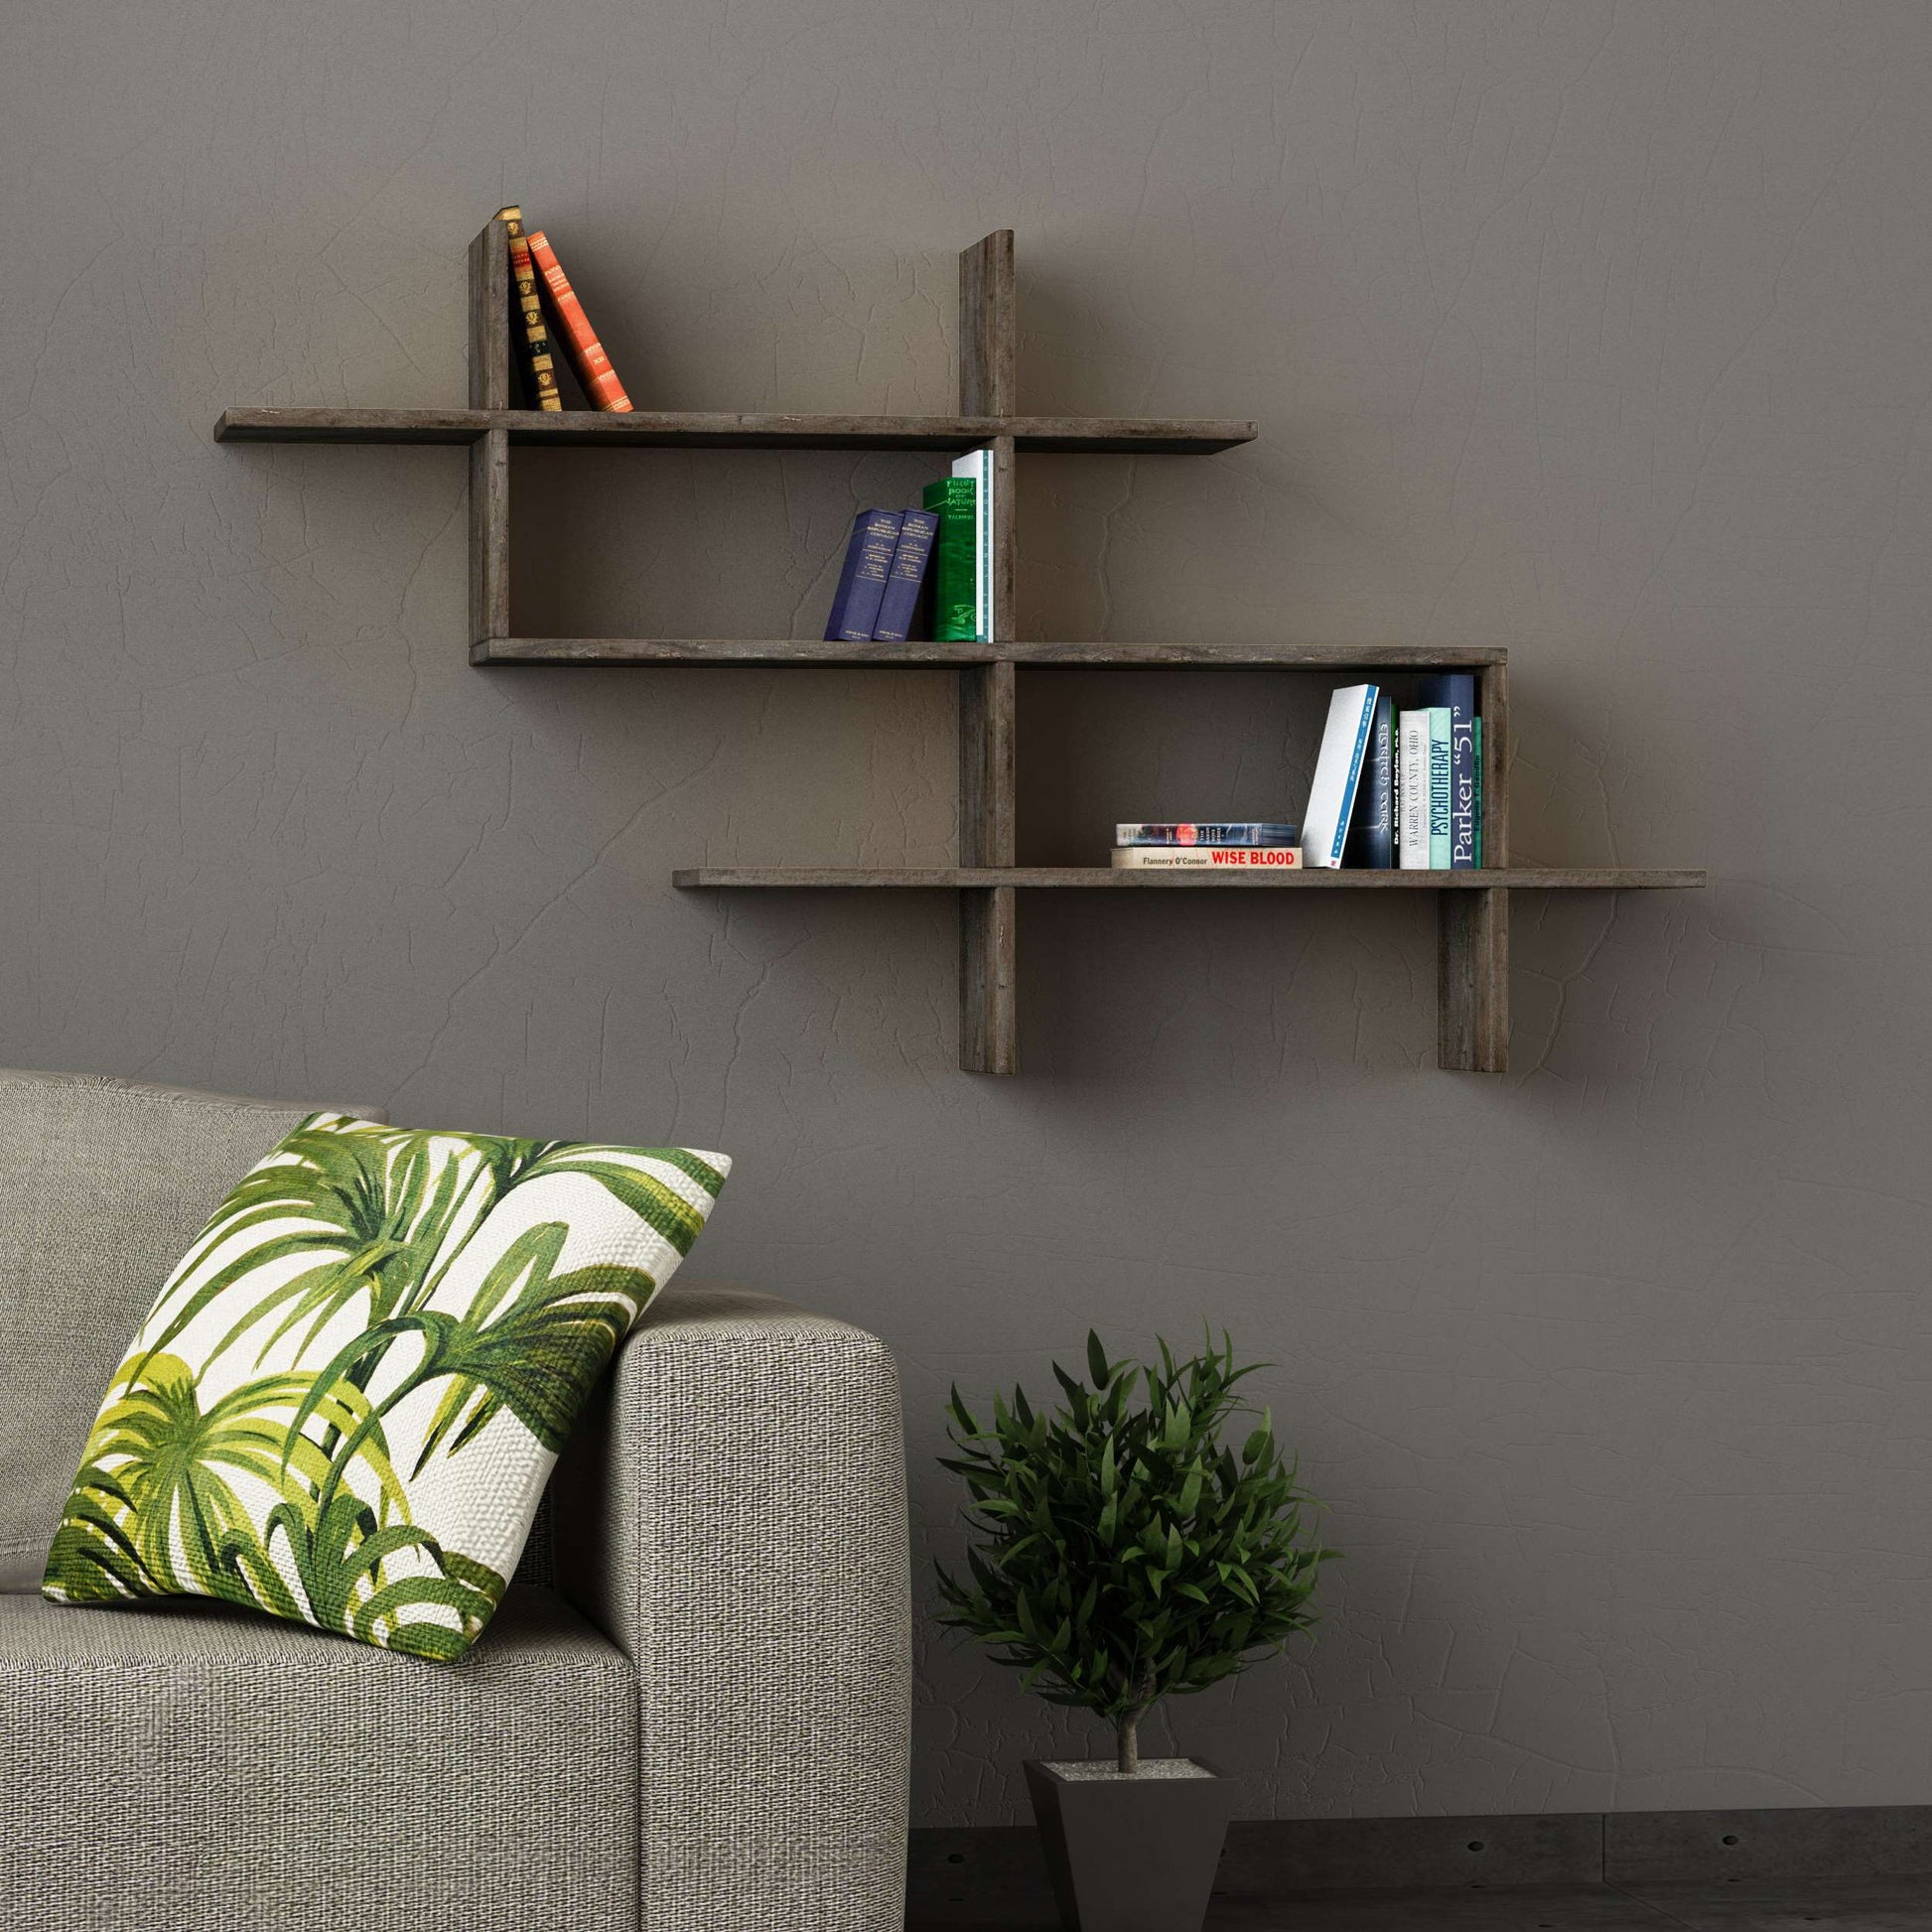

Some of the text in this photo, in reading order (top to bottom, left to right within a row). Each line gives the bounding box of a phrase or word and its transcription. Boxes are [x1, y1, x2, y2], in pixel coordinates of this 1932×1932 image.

[1409, 730, 1420, 846] WARREN COUNTY, OHIO
[1431, 740, 1449, 836] PSYCHOTHERAPY
[1453, 772, 1472, 863] Parker
[1143, 857, 1173, 866] Flannery
[1211, 852, 1246, 864] WISE
[1250, 852, 1294, 866] BLOOD
